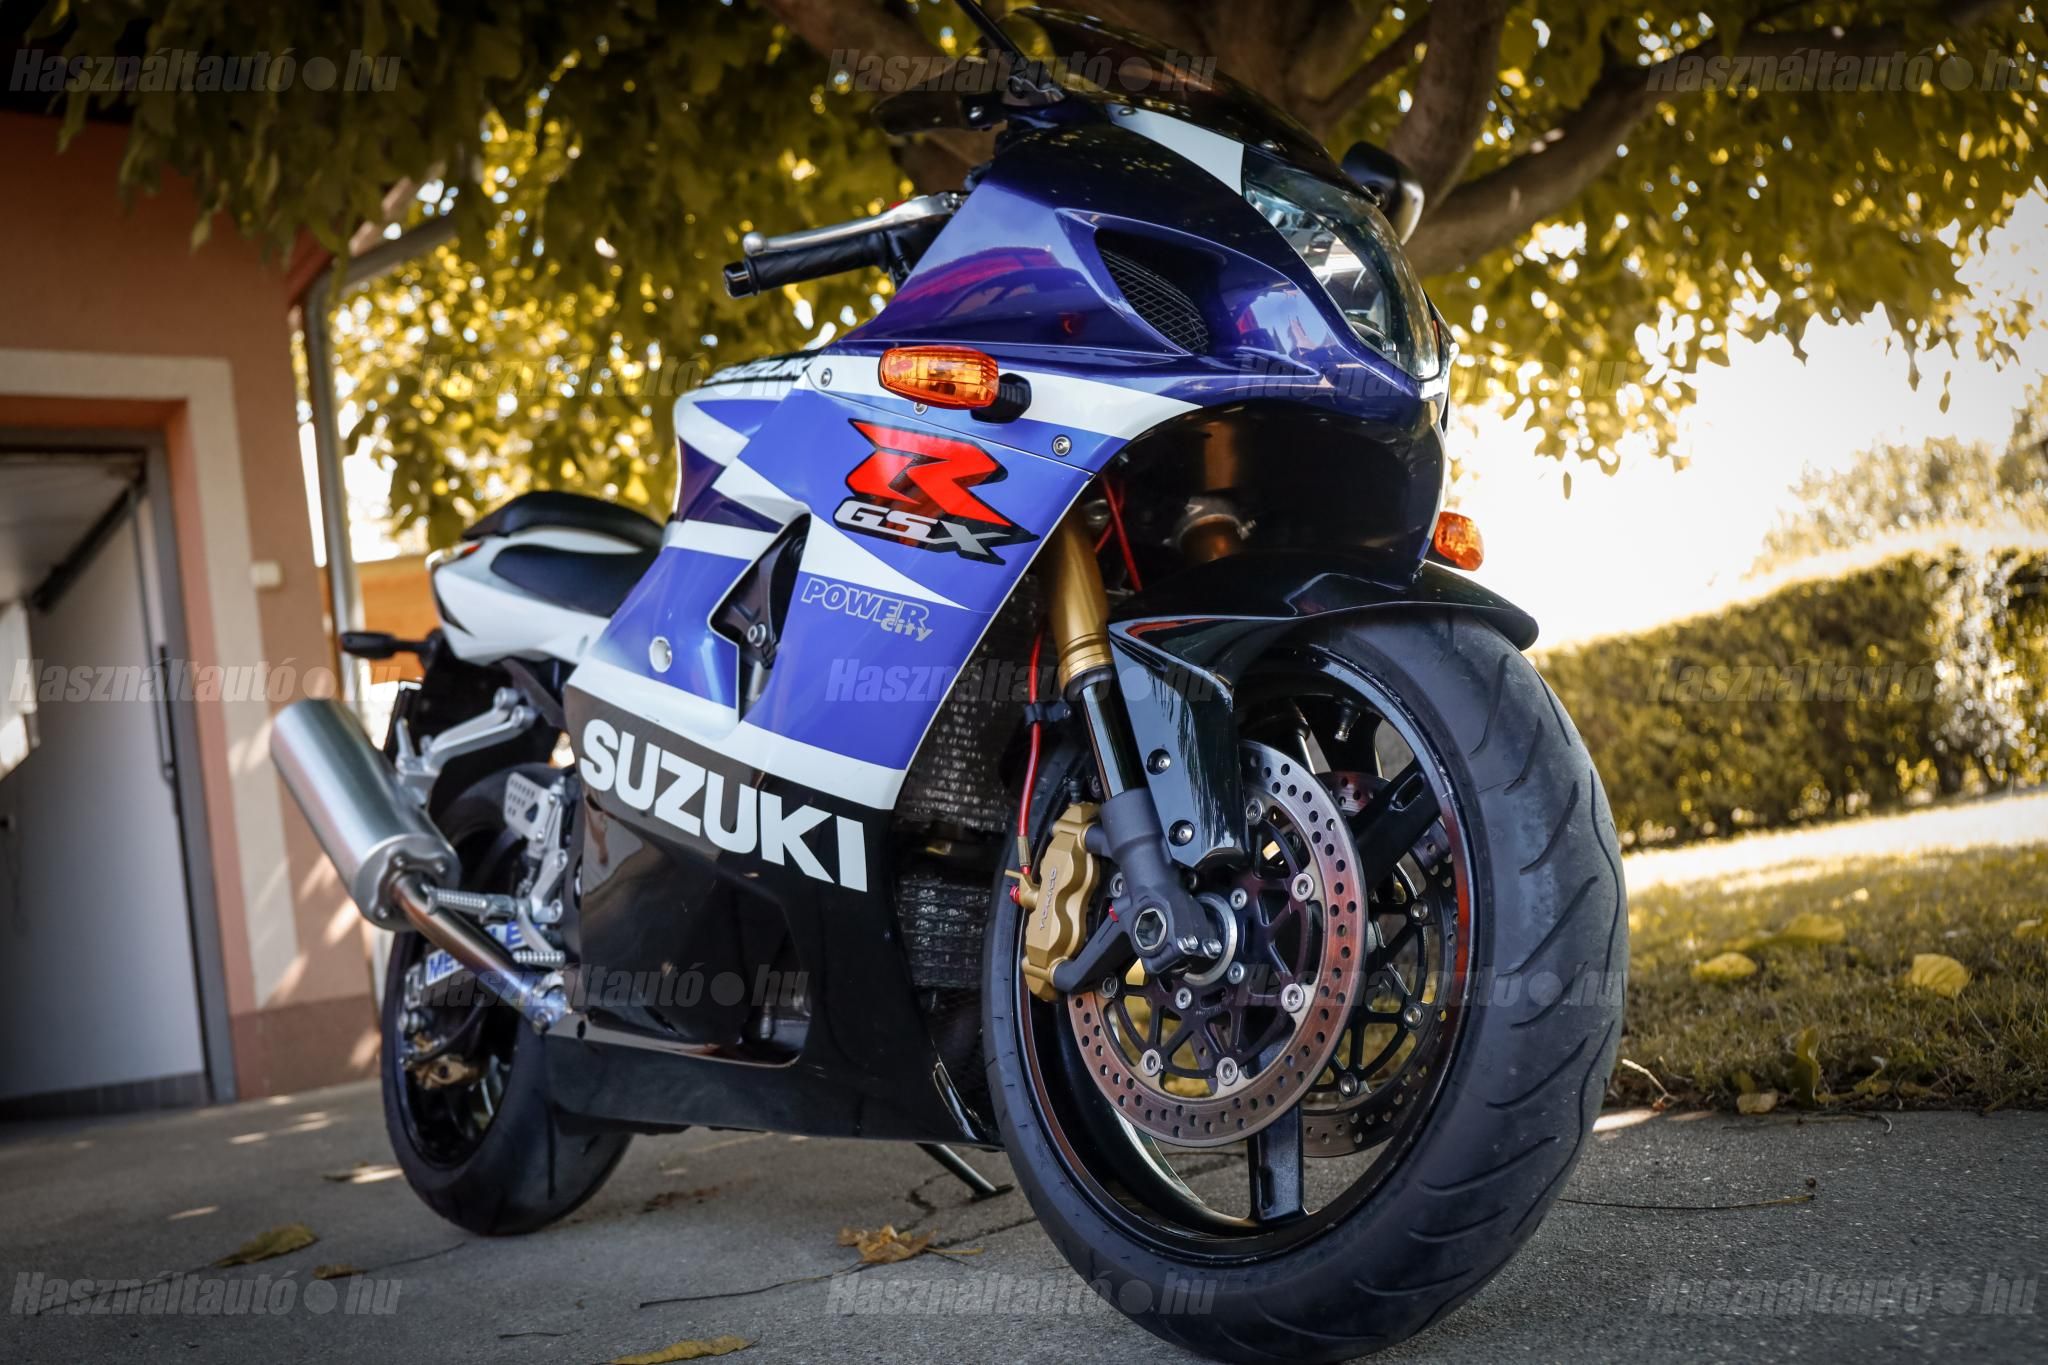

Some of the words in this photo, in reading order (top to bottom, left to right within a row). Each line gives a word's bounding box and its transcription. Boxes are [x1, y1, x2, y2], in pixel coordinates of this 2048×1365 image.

[846, 420, 1012, 528] R
[833, 499, 1012, 556] GSX
[801, 577, 930, 630] POWER
[579, 718, 868, 893] SUZUKI
